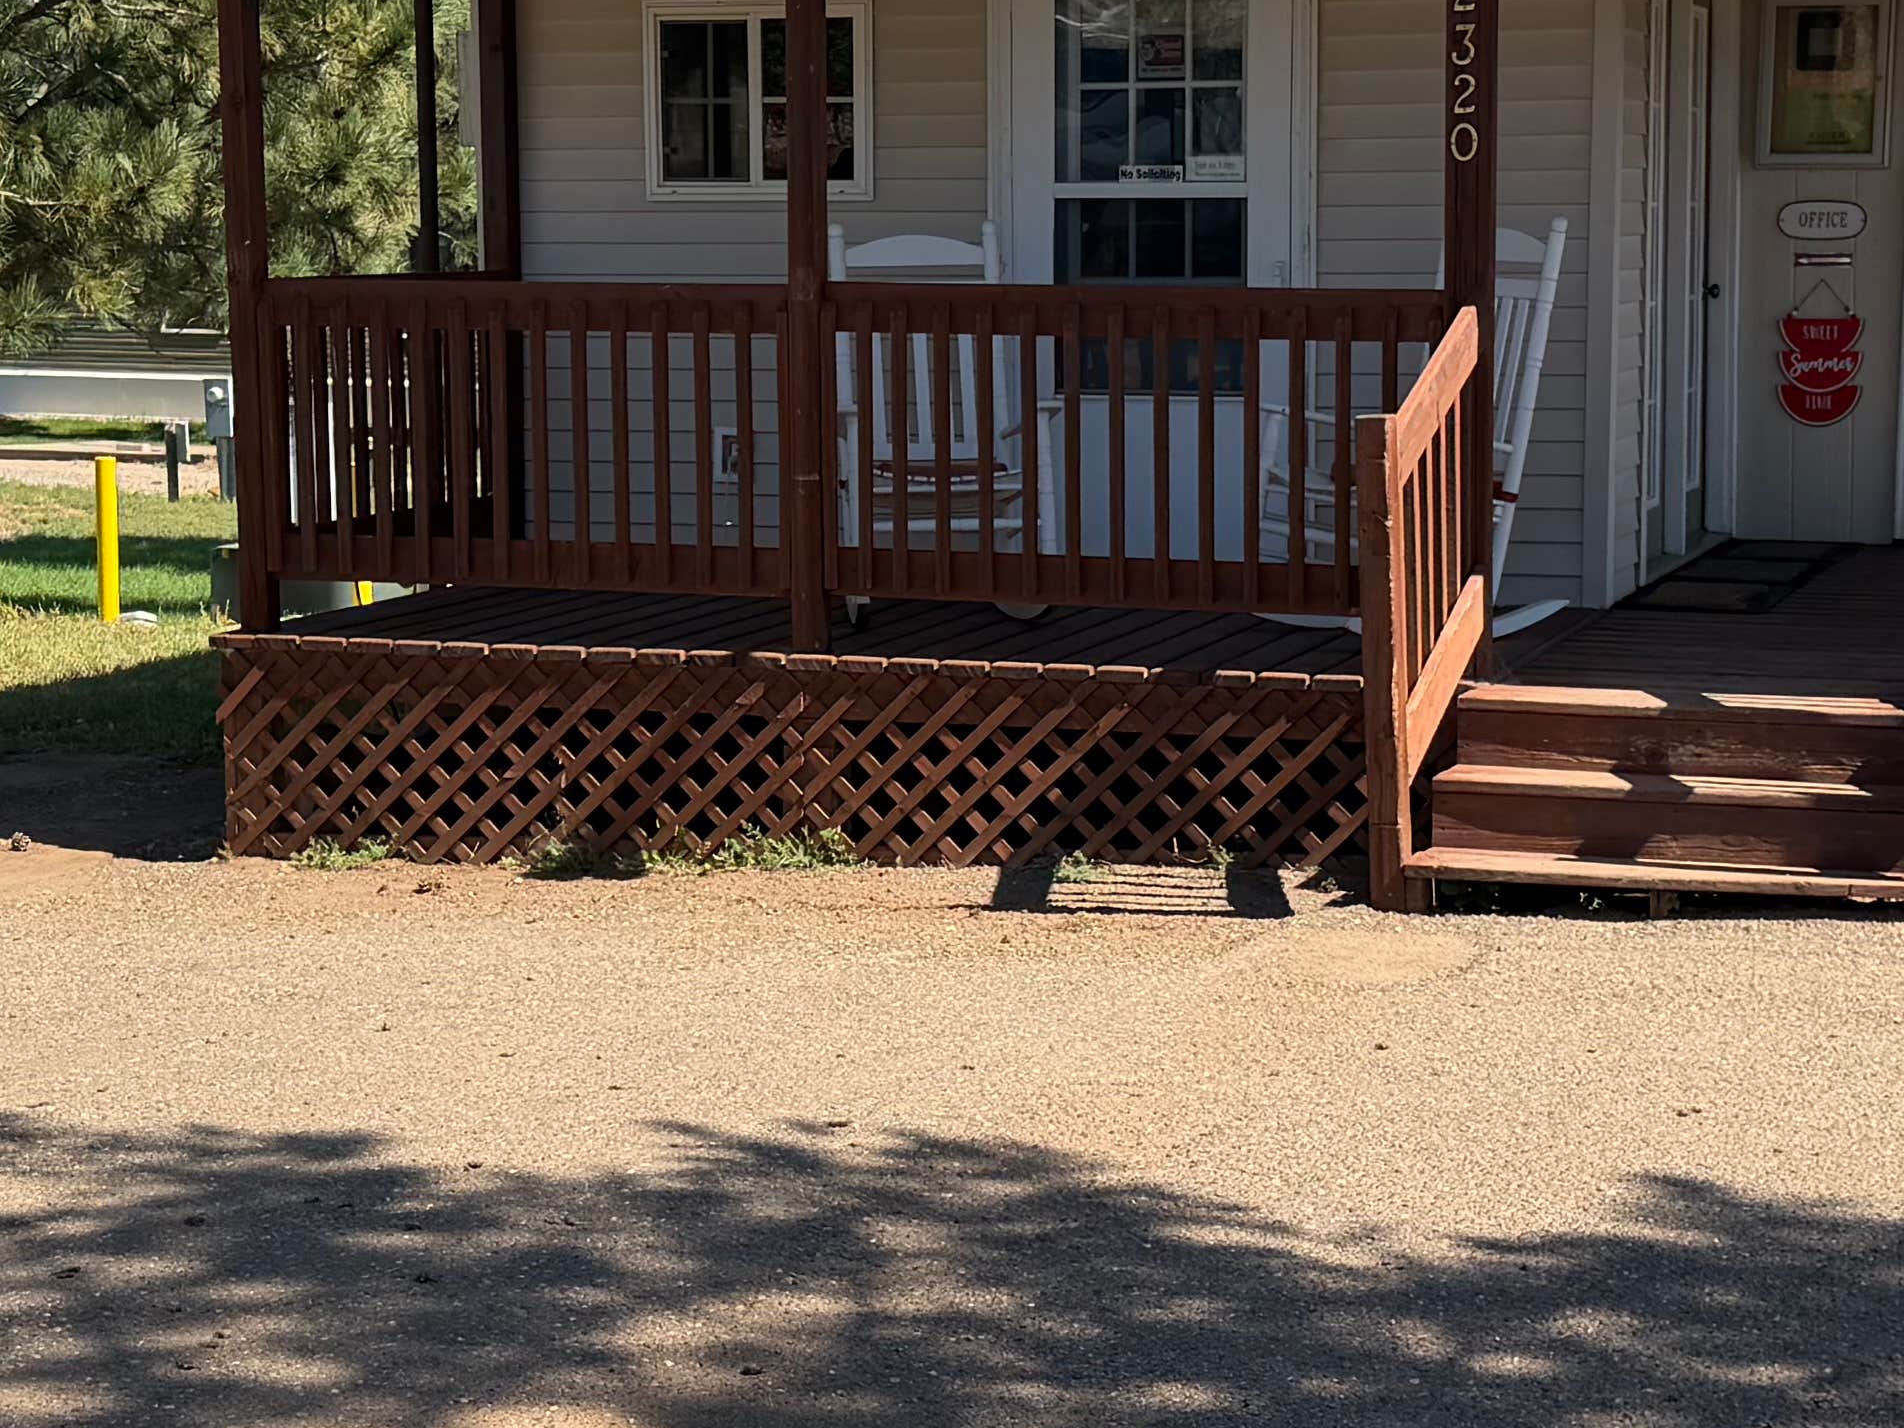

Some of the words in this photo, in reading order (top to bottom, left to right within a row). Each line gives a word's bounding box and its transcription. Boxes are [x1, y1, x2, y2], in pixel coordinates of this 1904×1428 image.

[1120, 169, 1134, 180] No
[1798, 211, 1849, 228] OFFICE
[1802, 324, 1839, 341] SWEET
[1788, 352, 1855, 378] Summer
